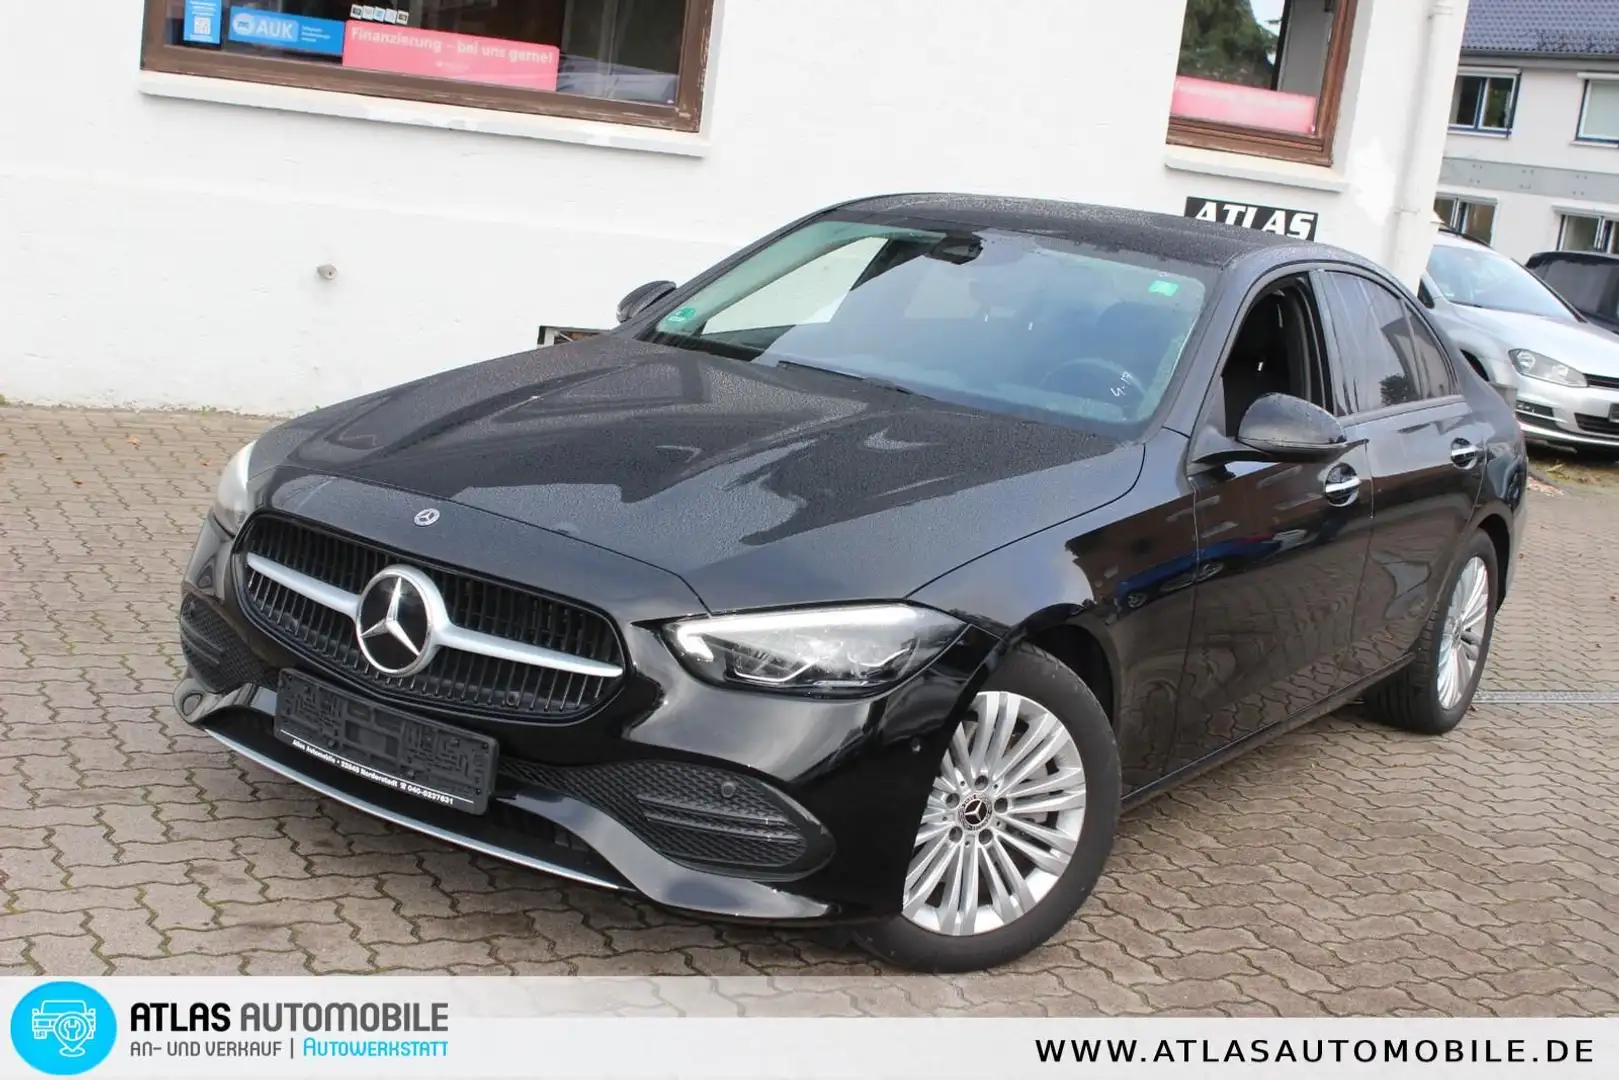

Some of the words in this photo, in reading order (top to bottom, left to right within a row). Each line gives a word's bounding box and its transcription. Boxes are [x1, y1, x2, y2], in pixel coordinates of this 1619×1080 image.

[256, 19, 293, 40] AUK
[351, 26, 442, 54] Finanzierung
[456, 40, 480, 56] bei
[482, 46, 506, 58] uns
[508, 49, 554, 65] gerne!
[1195, 201, 1315, 240] ATLAS
